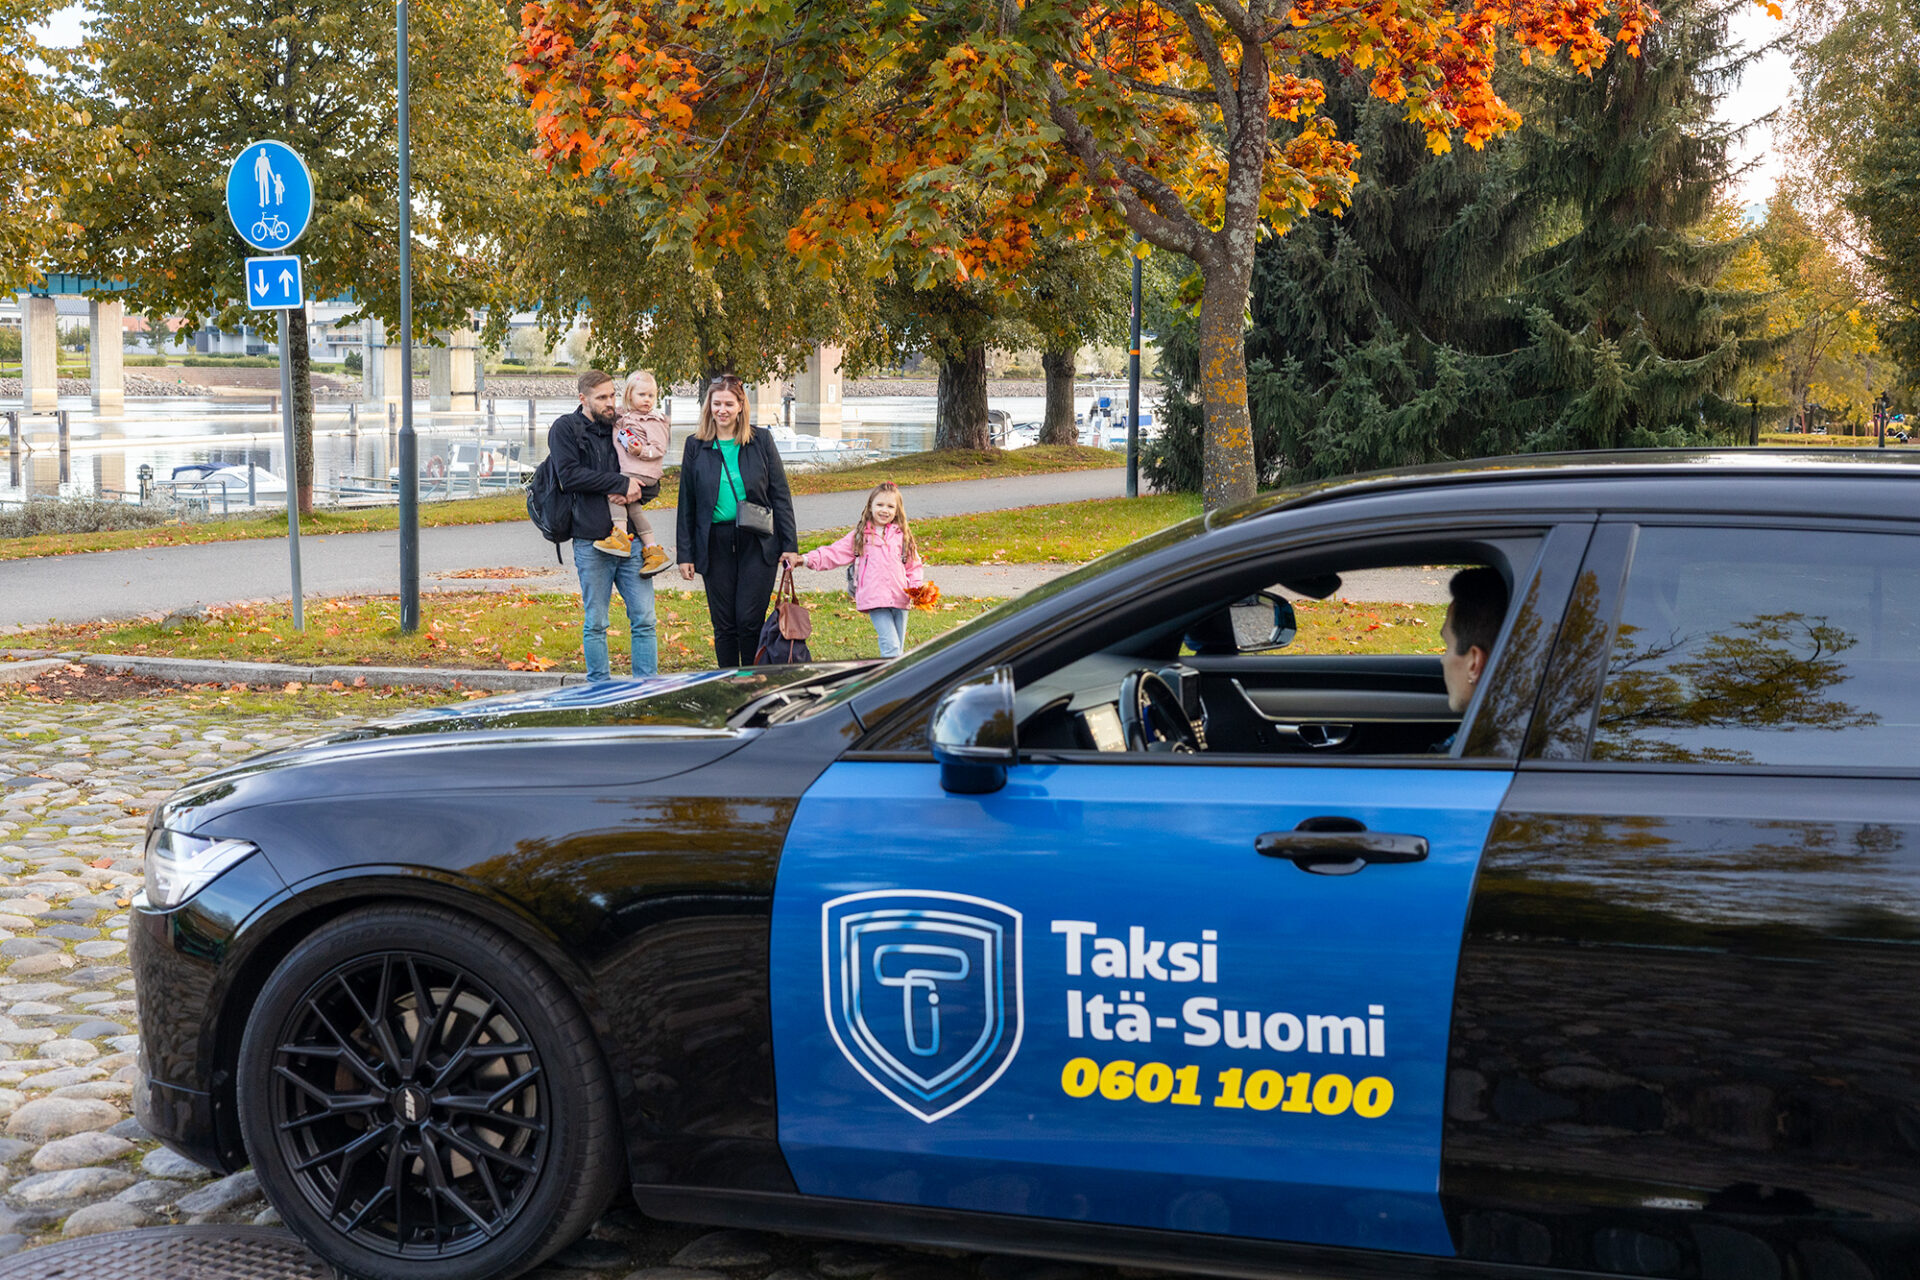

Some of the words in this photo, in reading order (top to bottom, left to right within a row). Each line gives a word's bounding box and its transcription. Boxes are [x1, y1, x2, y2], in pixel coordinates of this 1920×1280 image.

[1051, 919, 1218, 983] Taksi
[1067, 989, 1386, 1057] Itä-Suomi
[1061, 1057, 1202, 1106] 0601
[1214, 1068, 1394, 1118] 10100
